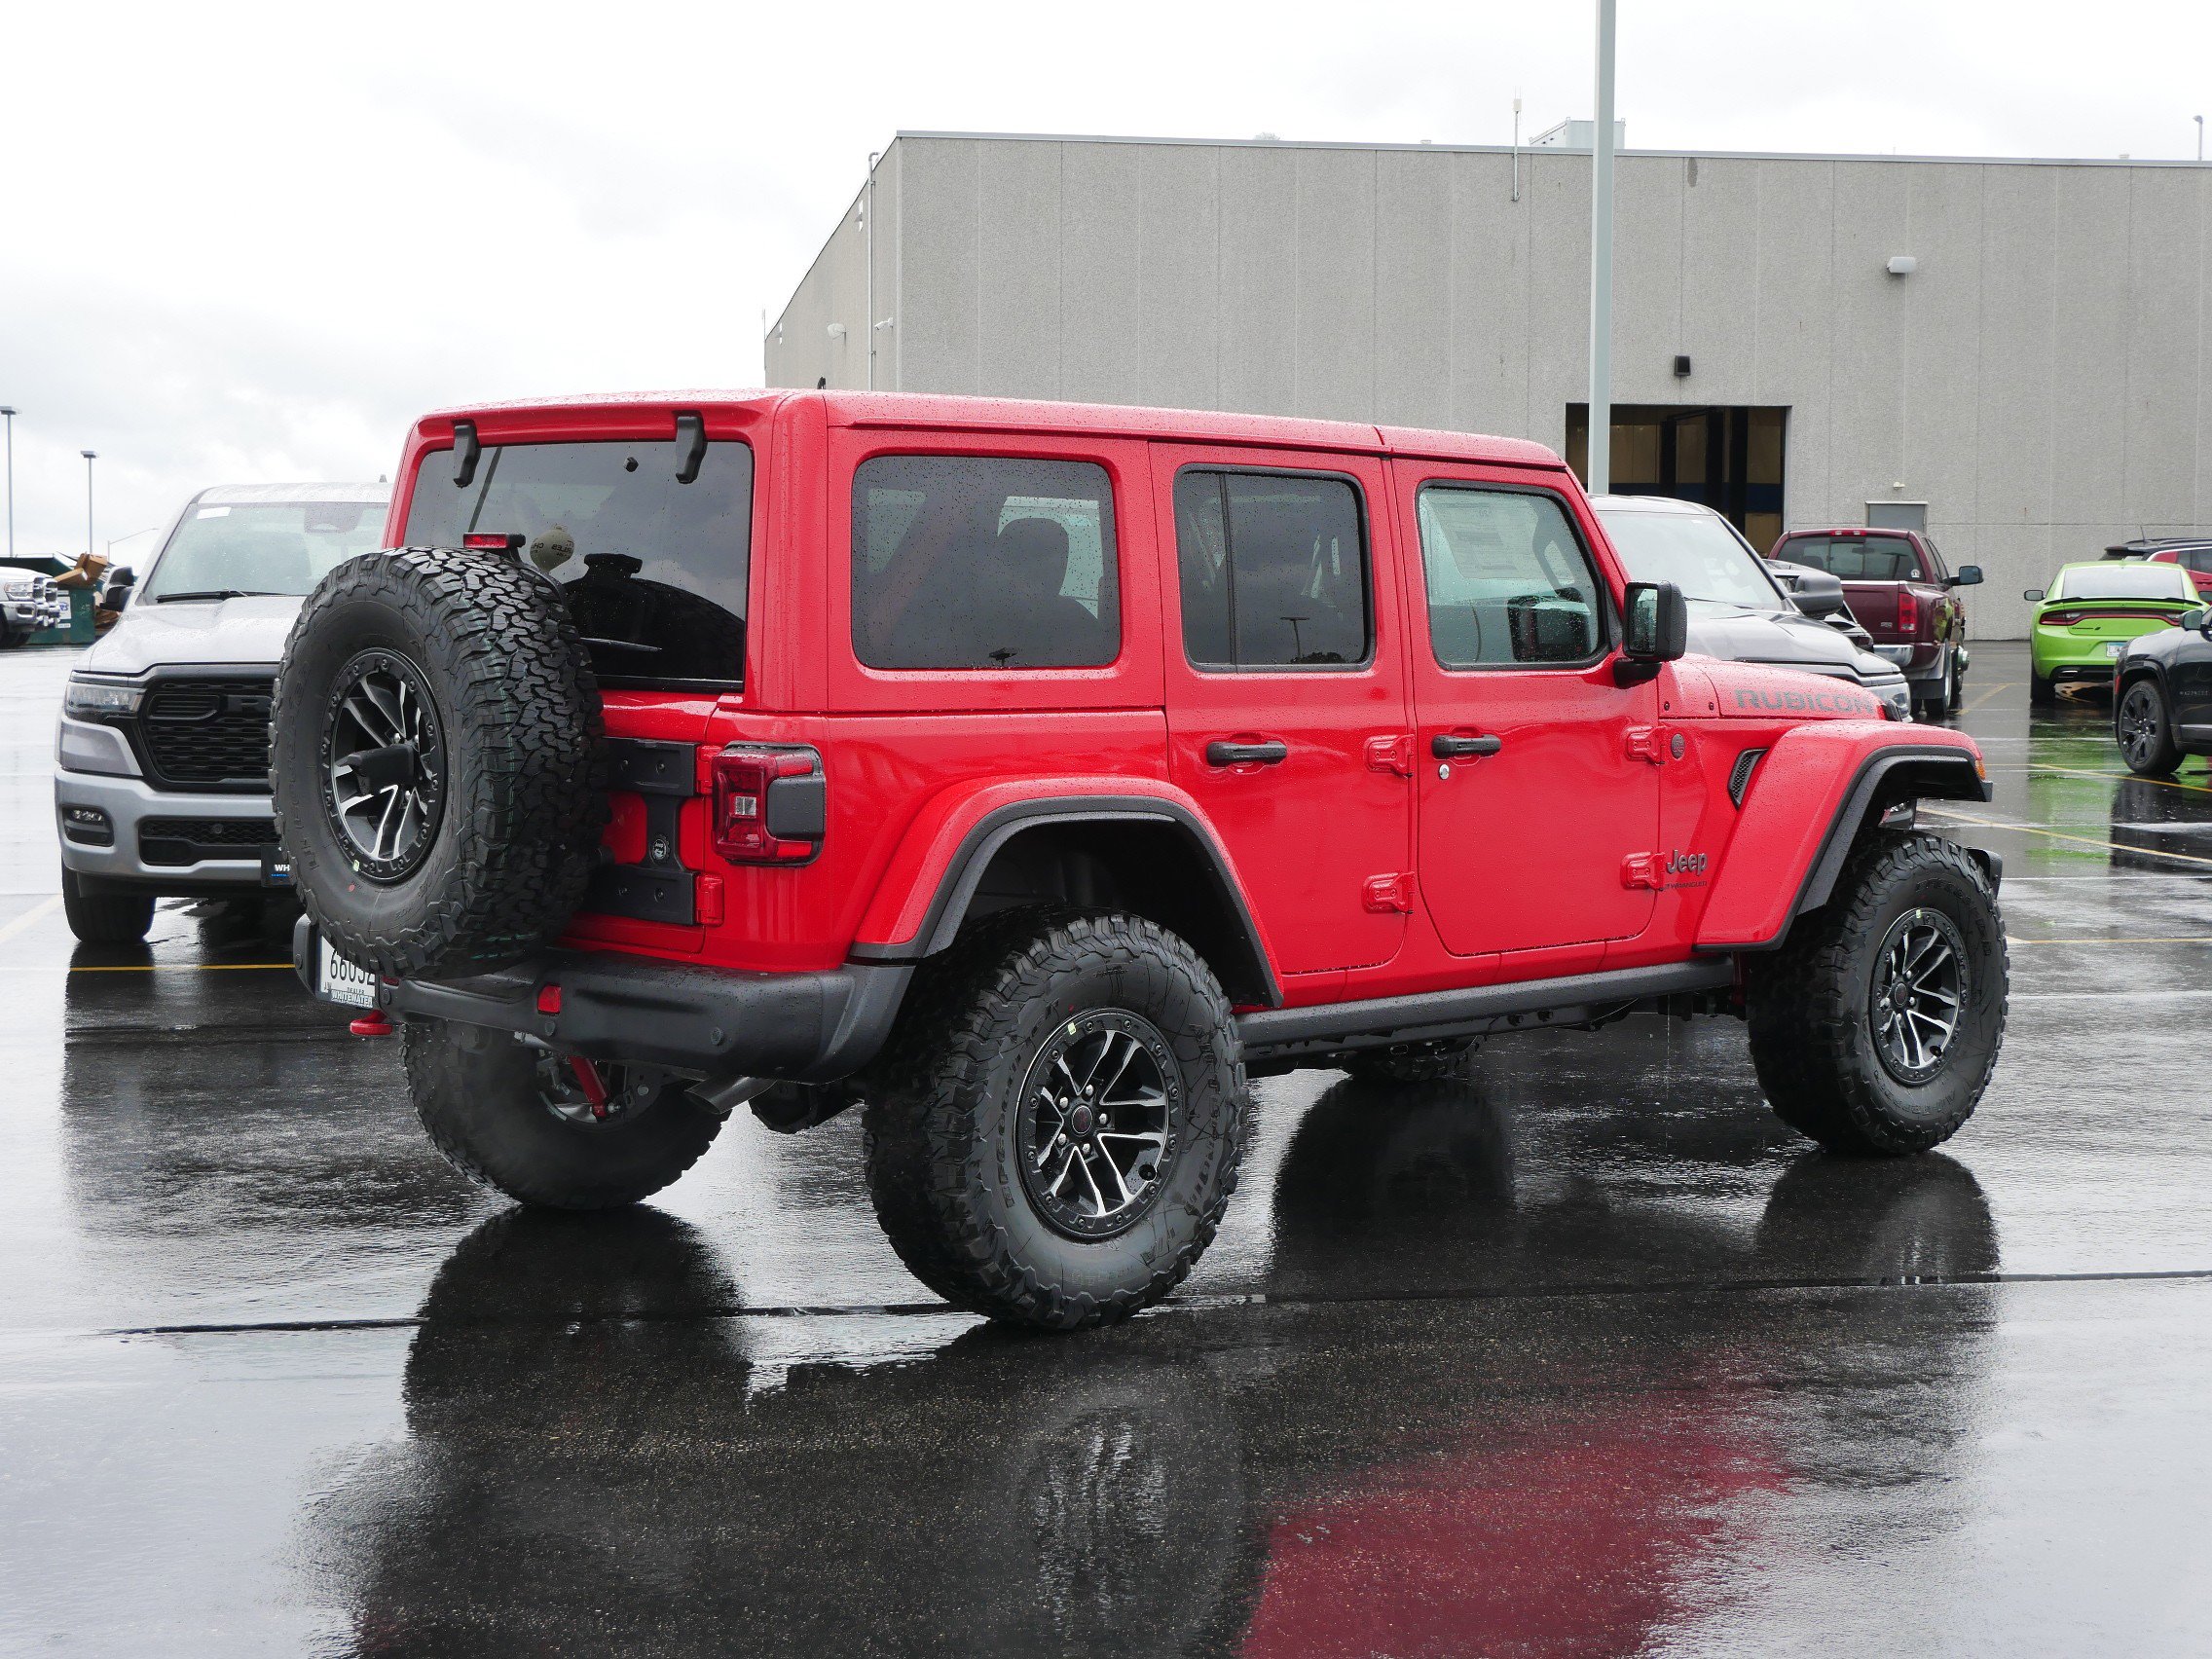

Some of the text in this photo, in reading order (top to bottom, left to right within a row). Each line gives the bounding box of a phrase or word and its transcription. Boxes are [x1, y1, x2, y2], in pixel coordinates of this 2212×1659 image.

[1734, 689, 1874, 714] RUBICON
[1666, 849, 1708, 876] Jeep
[331, 989, 373, 1007] WHITEWATER
